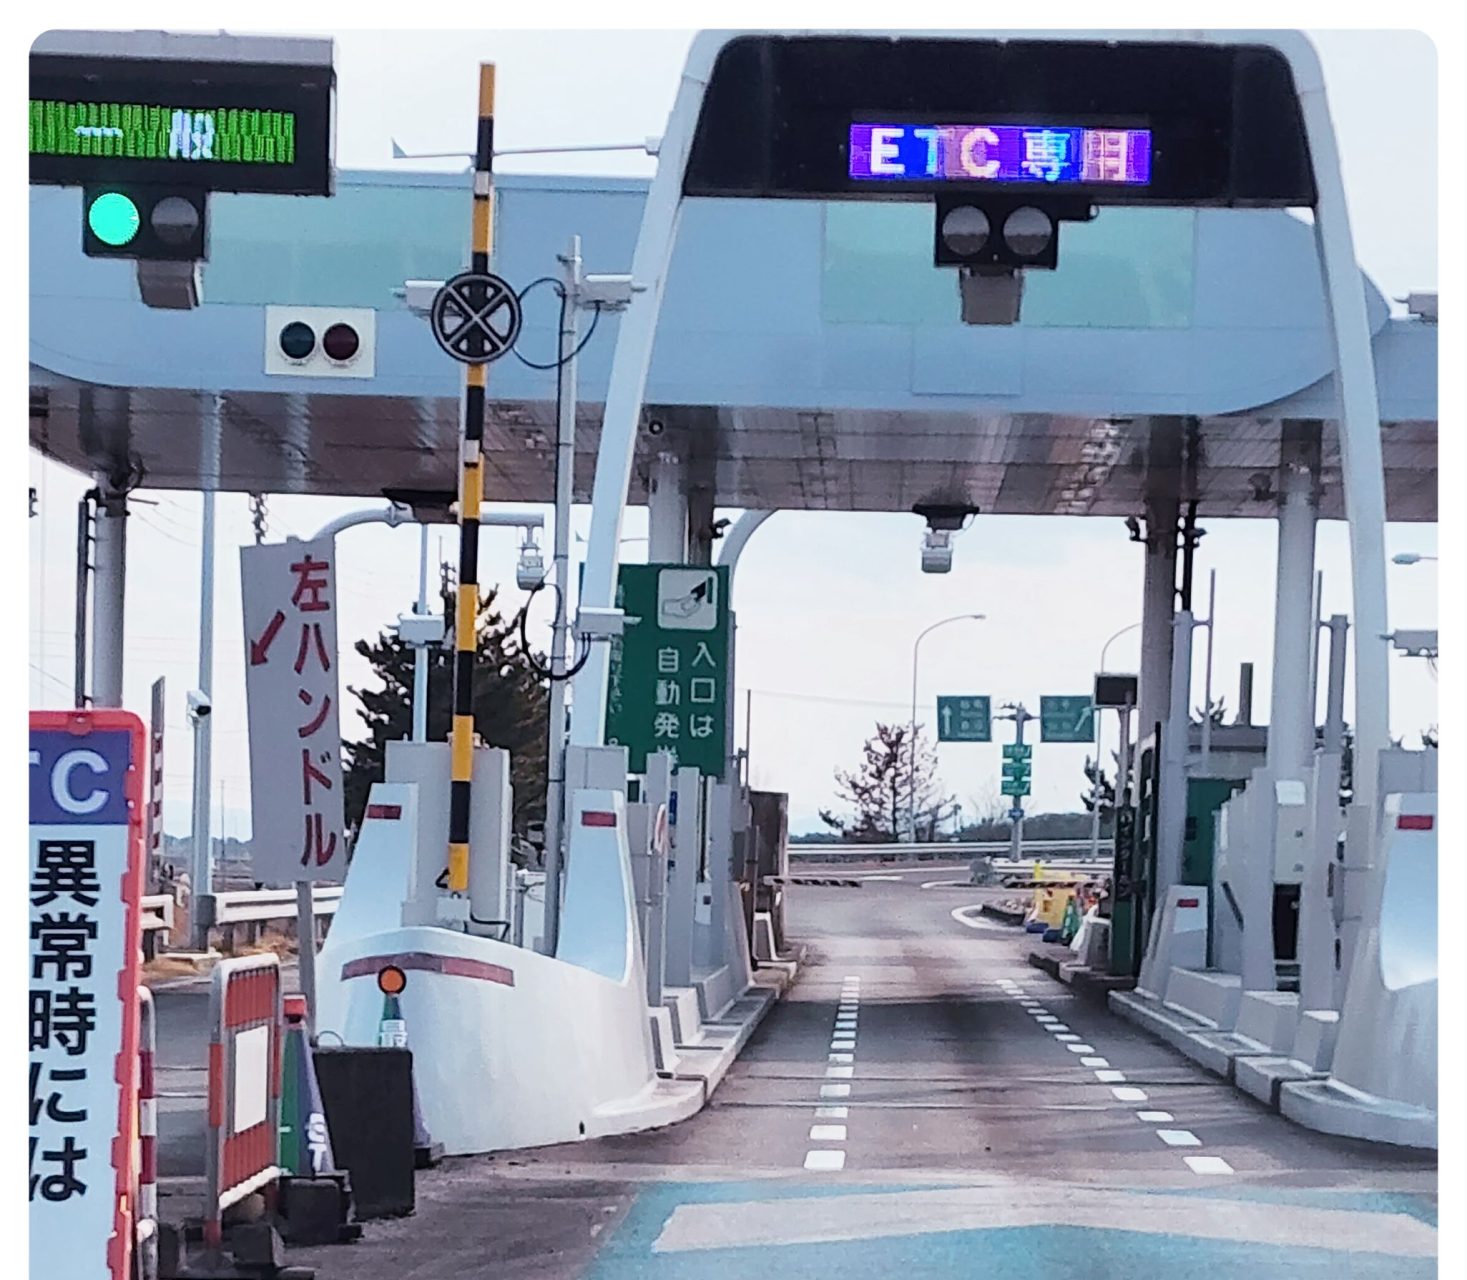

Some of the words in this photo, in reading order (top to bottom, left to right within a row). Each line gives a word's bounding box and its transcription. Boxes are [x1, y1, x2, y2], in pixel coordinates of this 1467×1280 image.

[870, 127, 1000, 178] ETC
[290, 554, 337, 867] 左ハンドル
[689, 641, 716, 738] 入口は
[29, 750, 110, 815] C
[29, 839, 101, 1202] 異常時には
